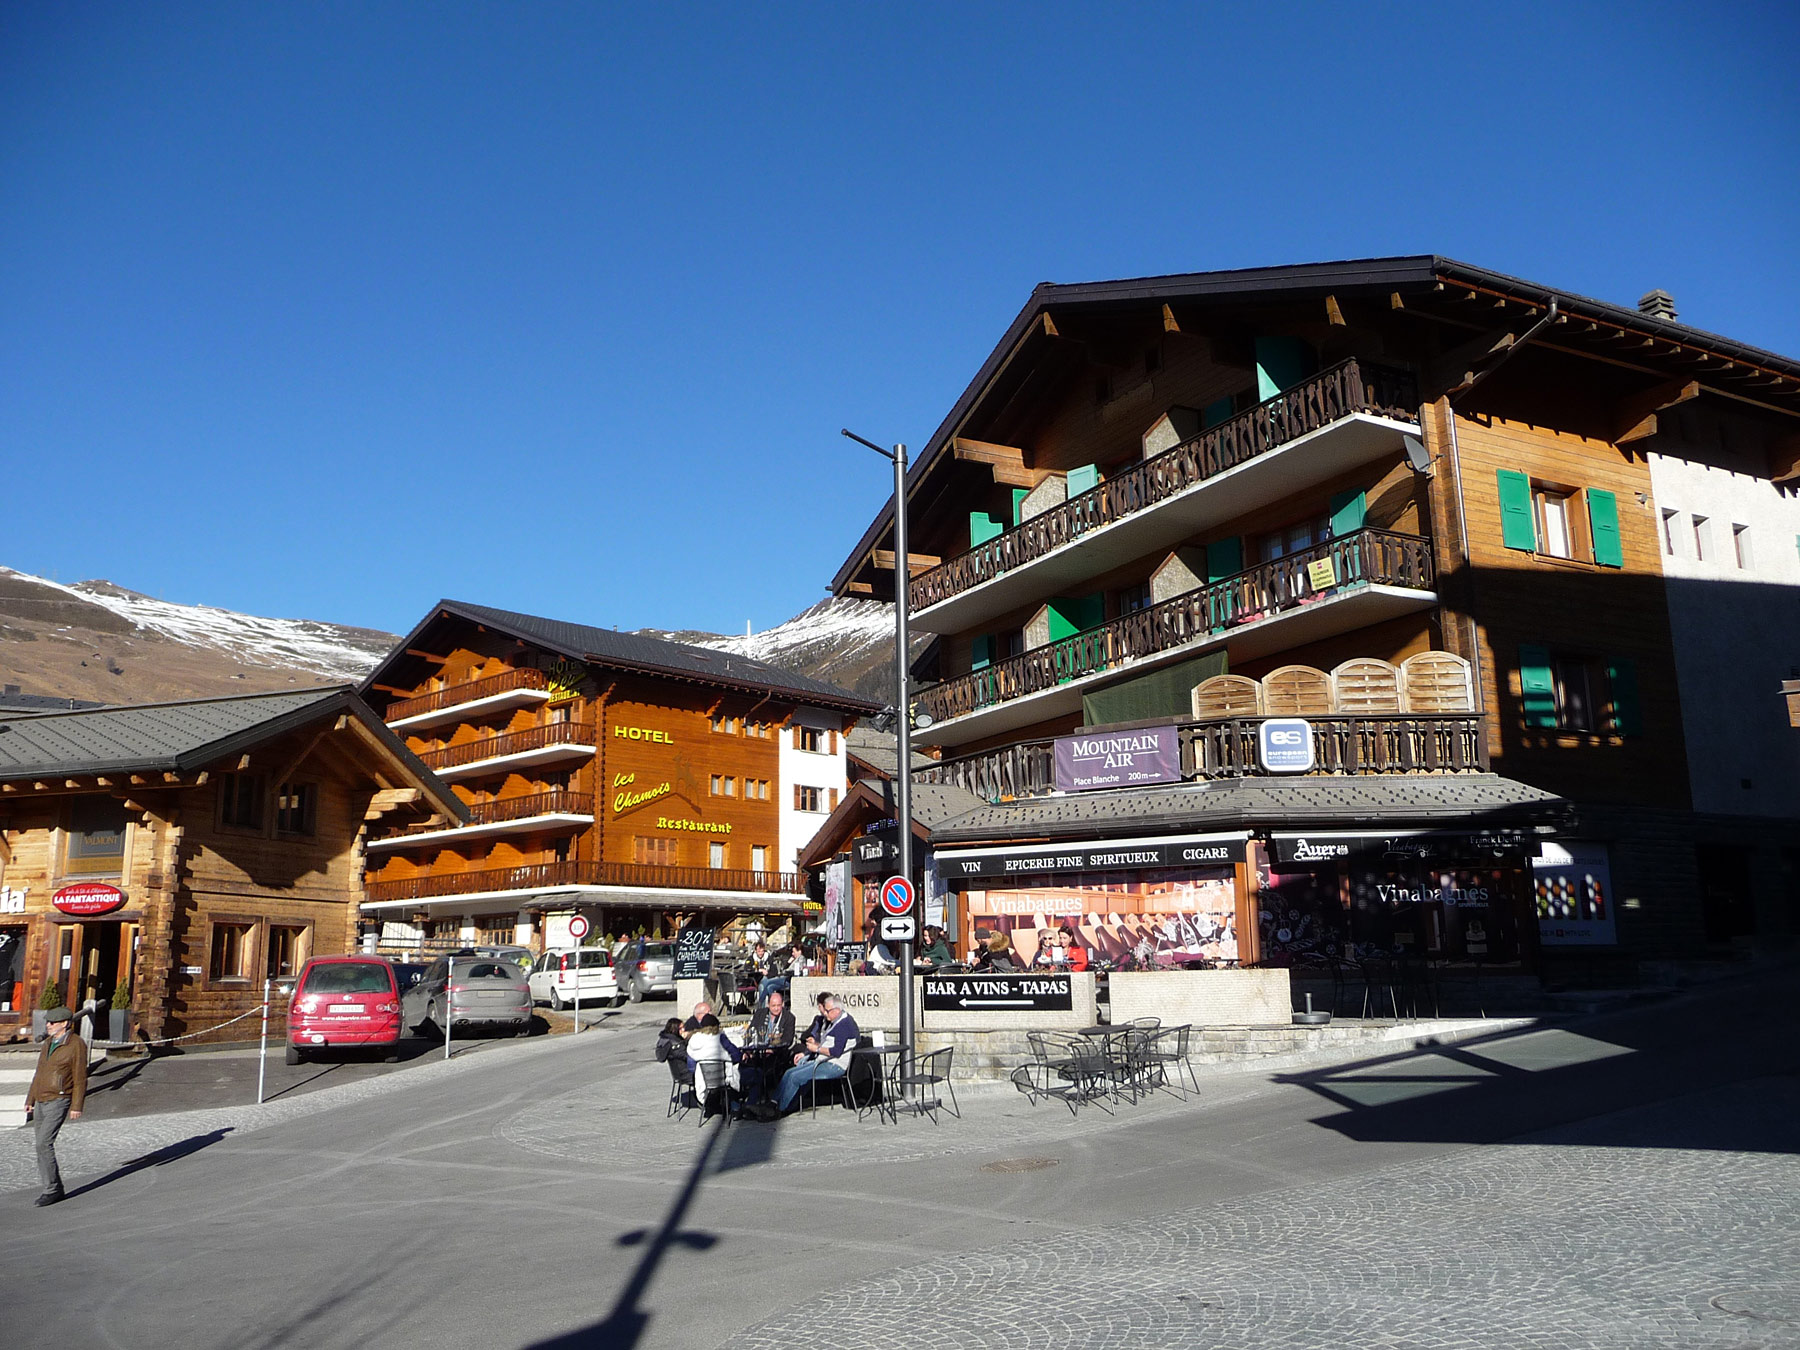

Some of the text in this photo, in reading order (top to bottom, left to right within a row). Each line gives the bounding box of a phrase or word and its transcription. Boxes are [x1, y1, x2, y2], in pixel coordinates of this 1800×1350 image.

[614, 726, 674, 744] HOTEL
[1271, 731, 1302, 744] es
[1072, 735, 1159, 757] MOUNTAIN
[1103, 752, 1134, 768] AIR
[613, 772, 635, 787] les
[1073, 777, 1092, 786] Place
[1092, 774, 1120, 784] Blanche
[613, 782, 670, 812] Chamois
[656, 817, 732, 834] Restaurant
[1295, 839, 1337, 857] Auer
[961, 848, 1229, 873] VIN EPICERIE FINE SPIRITUEUX CIGARE
[54, 893, 120, 904] LA FANTASTIQUE
[1376, 884, 1489, 905] Vinabagnes
[989, 895, 1083, 916] Vinabagnes
[926, 981, 957, 995] BAR
[960, 981, 971, 995] A
[972, 981, 1010, 995] VINS
[1019, 981, 1069, 995] TAPAS
